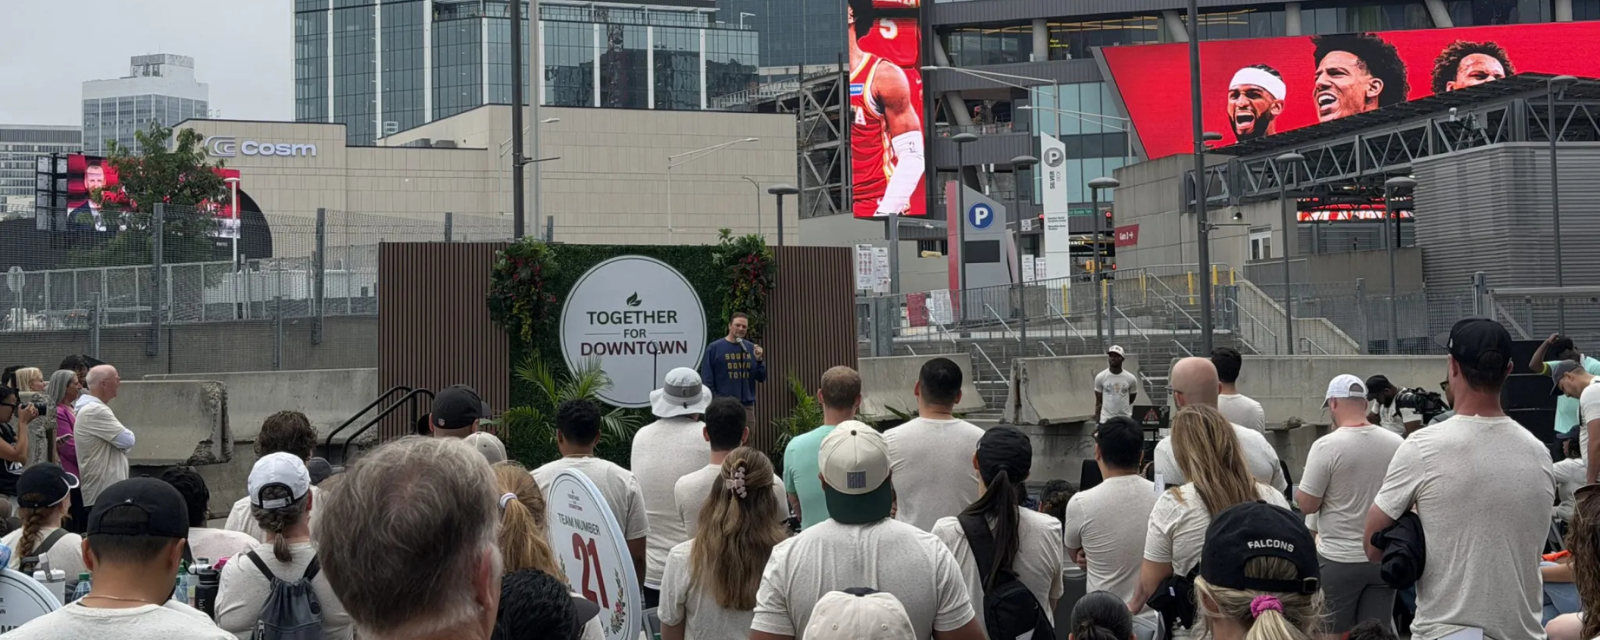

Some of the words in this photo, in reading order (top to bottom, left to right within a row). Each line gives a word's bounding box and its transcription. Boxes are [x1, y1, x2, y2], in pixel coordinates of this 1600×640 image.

[241, 140, 317, 156] Cosm
[1048, 151, 1060, 164] P
[974, 207, 989, 226] P
[586, 310, 678, 325] TOGETHER
[623, 328, 647, 339] FOR
[580, 341, 688, 357] DOWNTOWN
[724, 352, 752, 360] SOUTH
[557, 512, 575, 528] TEAM
[574, 517, 601, 536] NUMBER
[1247, 538, 1294, 552] FALCONS
[572, 532, 610, 609] 21
